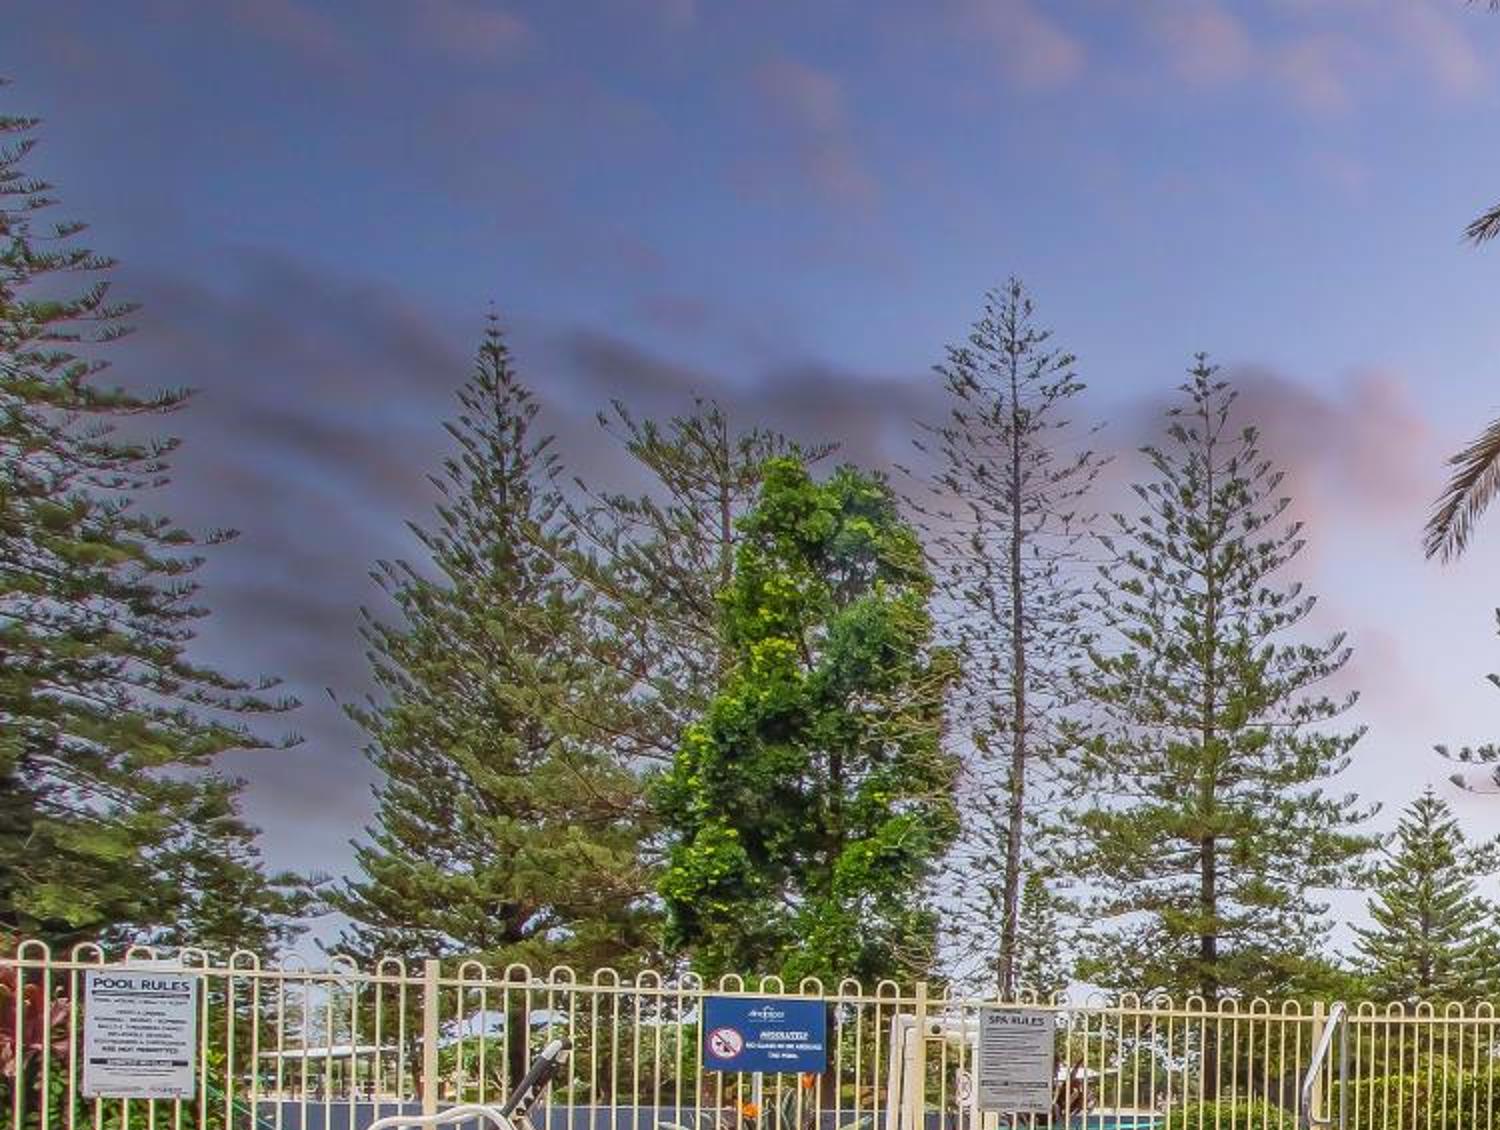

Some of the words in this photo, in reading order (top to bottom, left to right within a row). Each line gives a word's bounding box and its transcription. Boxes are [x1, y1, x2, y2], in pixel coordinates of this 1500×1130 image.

[93, 977, 136, 990] POOL
[141, 979, 191, 992] RULES
[988, 1015, 1009, 1025] SPA
[1011, 1016, 1045, 1026] RULES
